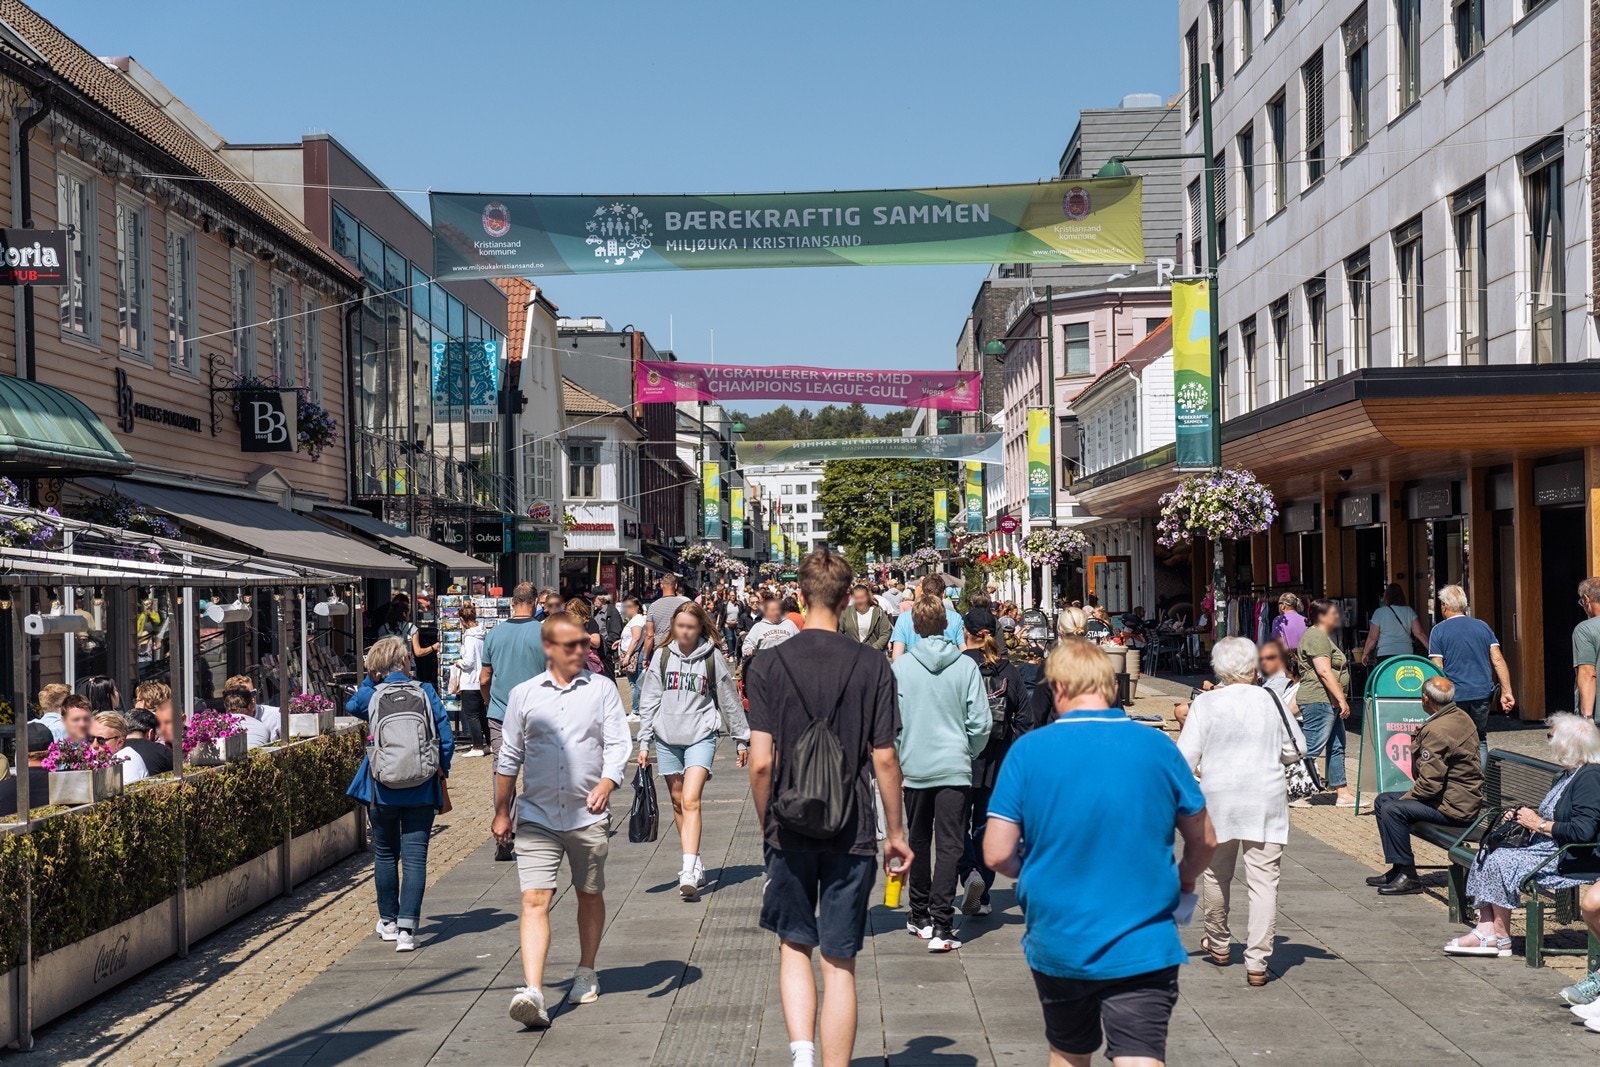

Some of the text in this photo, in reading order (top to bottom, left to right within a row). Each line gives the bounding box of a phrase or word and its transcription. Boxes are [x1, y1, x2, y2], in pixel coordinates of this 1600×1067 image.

[664, 203, 990, 231] BÆREKRAFTIG SAMMEN
[1053, 225, 1102, 233] Kristiansand
[1059, 233, 1097, 241] kommune
[474, 240, 522, 250] Kristiansand
[666, 237, 739, 253] MILJØUKA
[752, 234, 862, 250] KRISTIANSAND
[479, 248, 517, 257] kommune
[452, 261, 545, 273] www.miljoukakristiansand.no
[10, 270, 38, 281] PUB
[703, 367, 913, 385] VI GRATULERER VIPERS MED
[708, 380, 908, 399] CHAMPIONS LEAGUE-GULL
[529, 505, 550, 515] BURGER
[530, 510, 551, 519] KING
[475, 533, 501, 542] Cubus
[763, 629, 791, 639] MICHIGAN
[1392, 744, 1399, 761] 3
